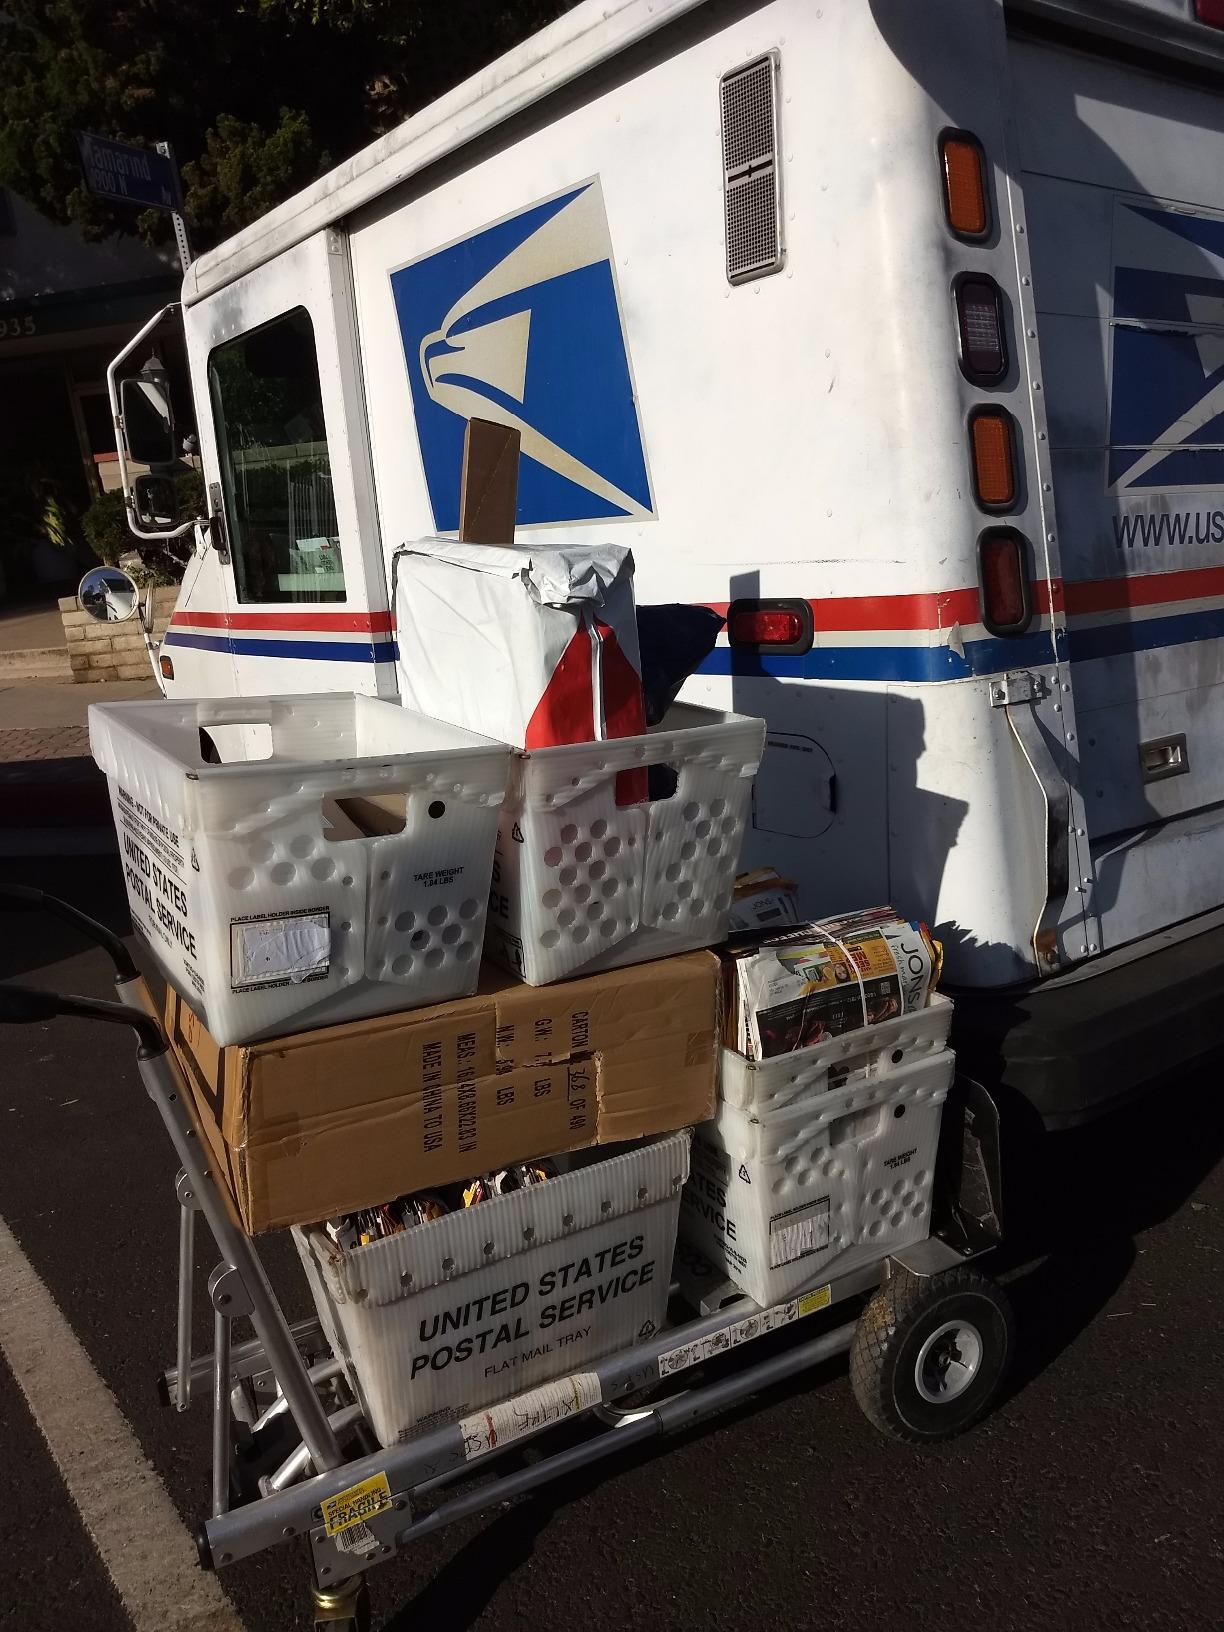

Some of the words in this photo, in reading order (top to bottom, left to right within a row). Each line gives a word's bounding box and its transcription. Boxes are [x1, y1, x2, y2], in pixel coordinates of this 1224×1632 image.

[123, 832, 151, 878] UNITED
[152, 862, 188, 918] STATES
[413, 872, 434, 882] TARE
[435, 866, 464, 878] WEIGHT
[439, 876, 454, 885] LBS
[125, 862, 156, 914] POSTAL
[156, 897, 198, 961] SERVICE
[571, 1011, 589, 1048] CARTON
[423, 1041, 442, 1070] MADE
[423, 1070, 442, 1083] IN
[534, 1078, 552, 1098] LBS
[423, 1084, 442, 1115] CHINA
[496, 1086, 515, 1106] LBS
[569, 1098, 586, 1110] OF
[424, 1113, 443, 1129] TO
[424, 1130, 443, 1153] USA
[458, 1140, 478, 1153] IN
[419, 1282, 531, 1343] UNITED
[537, 1235, 645, 1298] STATES
[410, 1321, 531, 1380] POSTAL
[538, 1260, 656, 1330] SERVICE
[484, 1355, 519, 1379] FLAT
[521, 1341, 554, 1364] MAIL
[555, 1326, 592, 1352] TRAY
[327, 1503, 352, 1518] SPECIAL
[329, 1490, 388, 1530] FRAGILE
